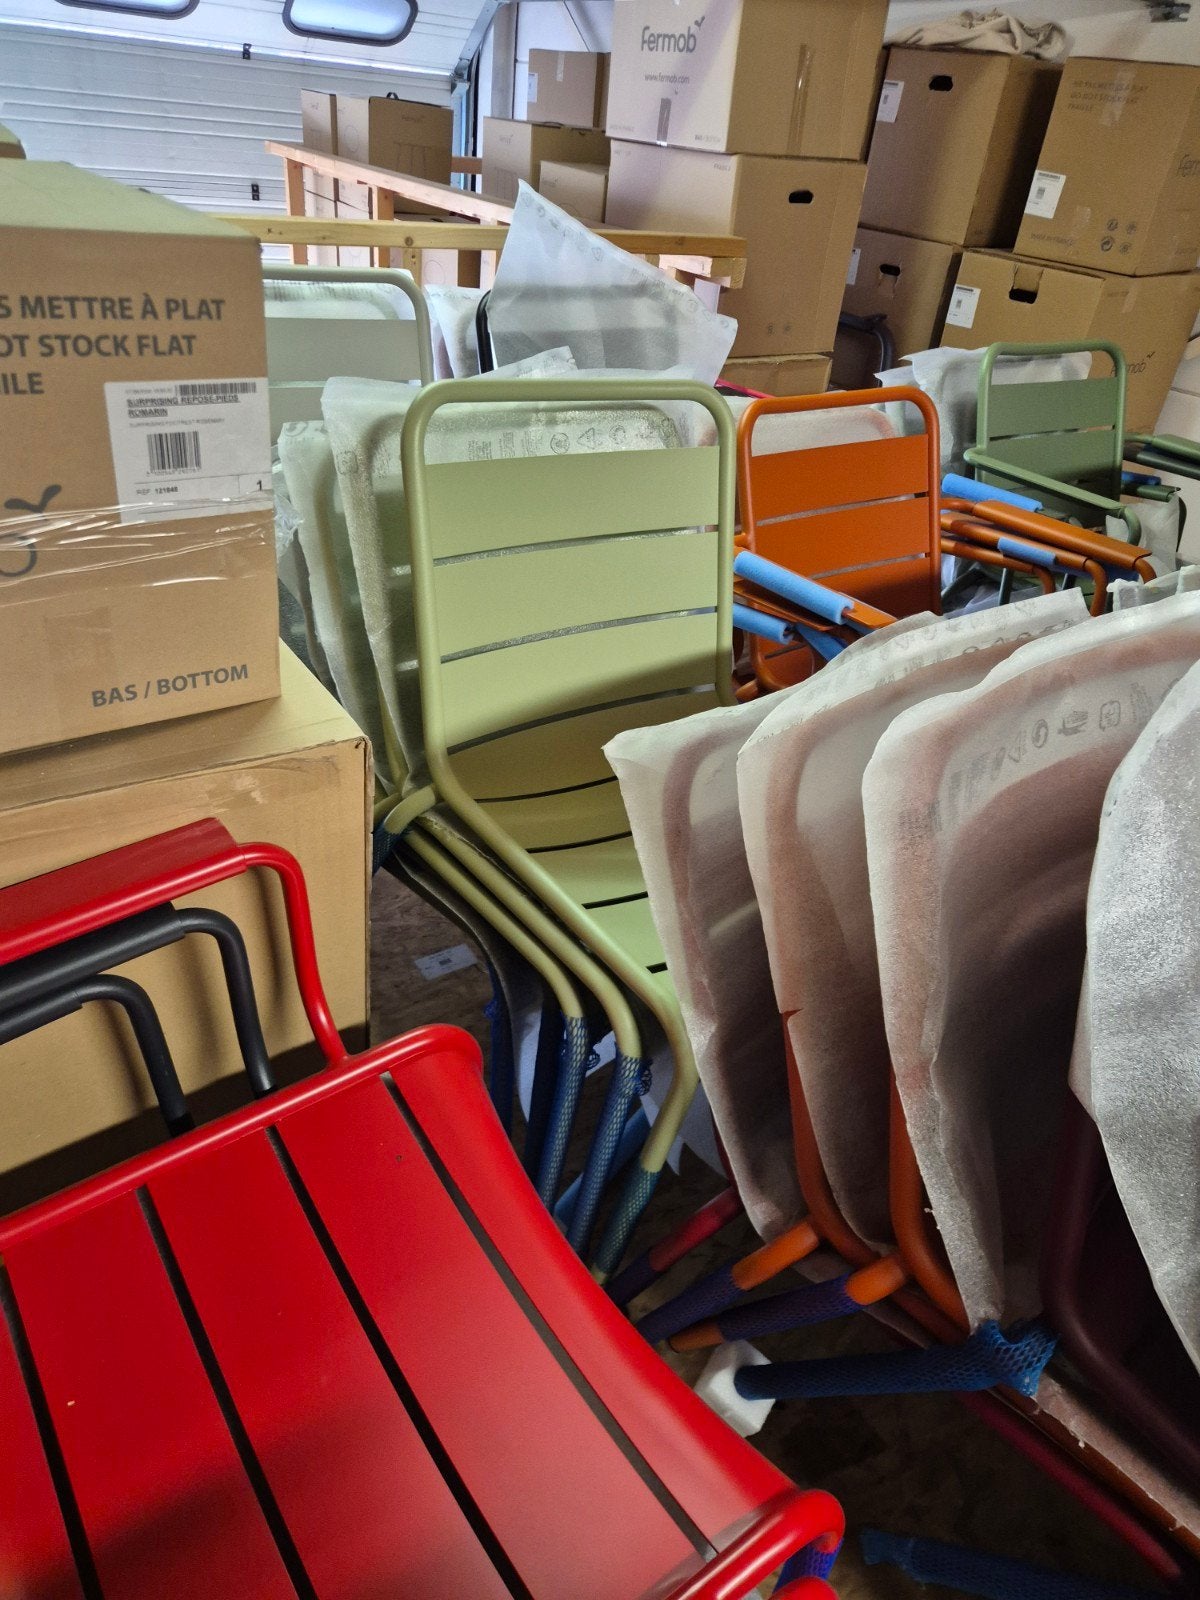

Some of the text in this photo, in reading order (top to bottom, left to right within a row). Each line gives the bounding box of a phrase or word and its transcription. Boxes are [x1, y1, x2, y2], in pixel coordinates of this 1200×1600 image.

[20, 296, 135, 320] METTRE
[142, 293, 159, 320] À
[166, 299, 226, 321] PLAT
[38, 334, 132, 358] STOCK
[136, 334, 197, 356] FLAT
[127, 397, 178, 407] SURPRISING
[128, 407, 168, 418] ROMARIN
[256, 479, 263, 491] 1
[92, 664, 249, 707] BAS / BOTTOM
